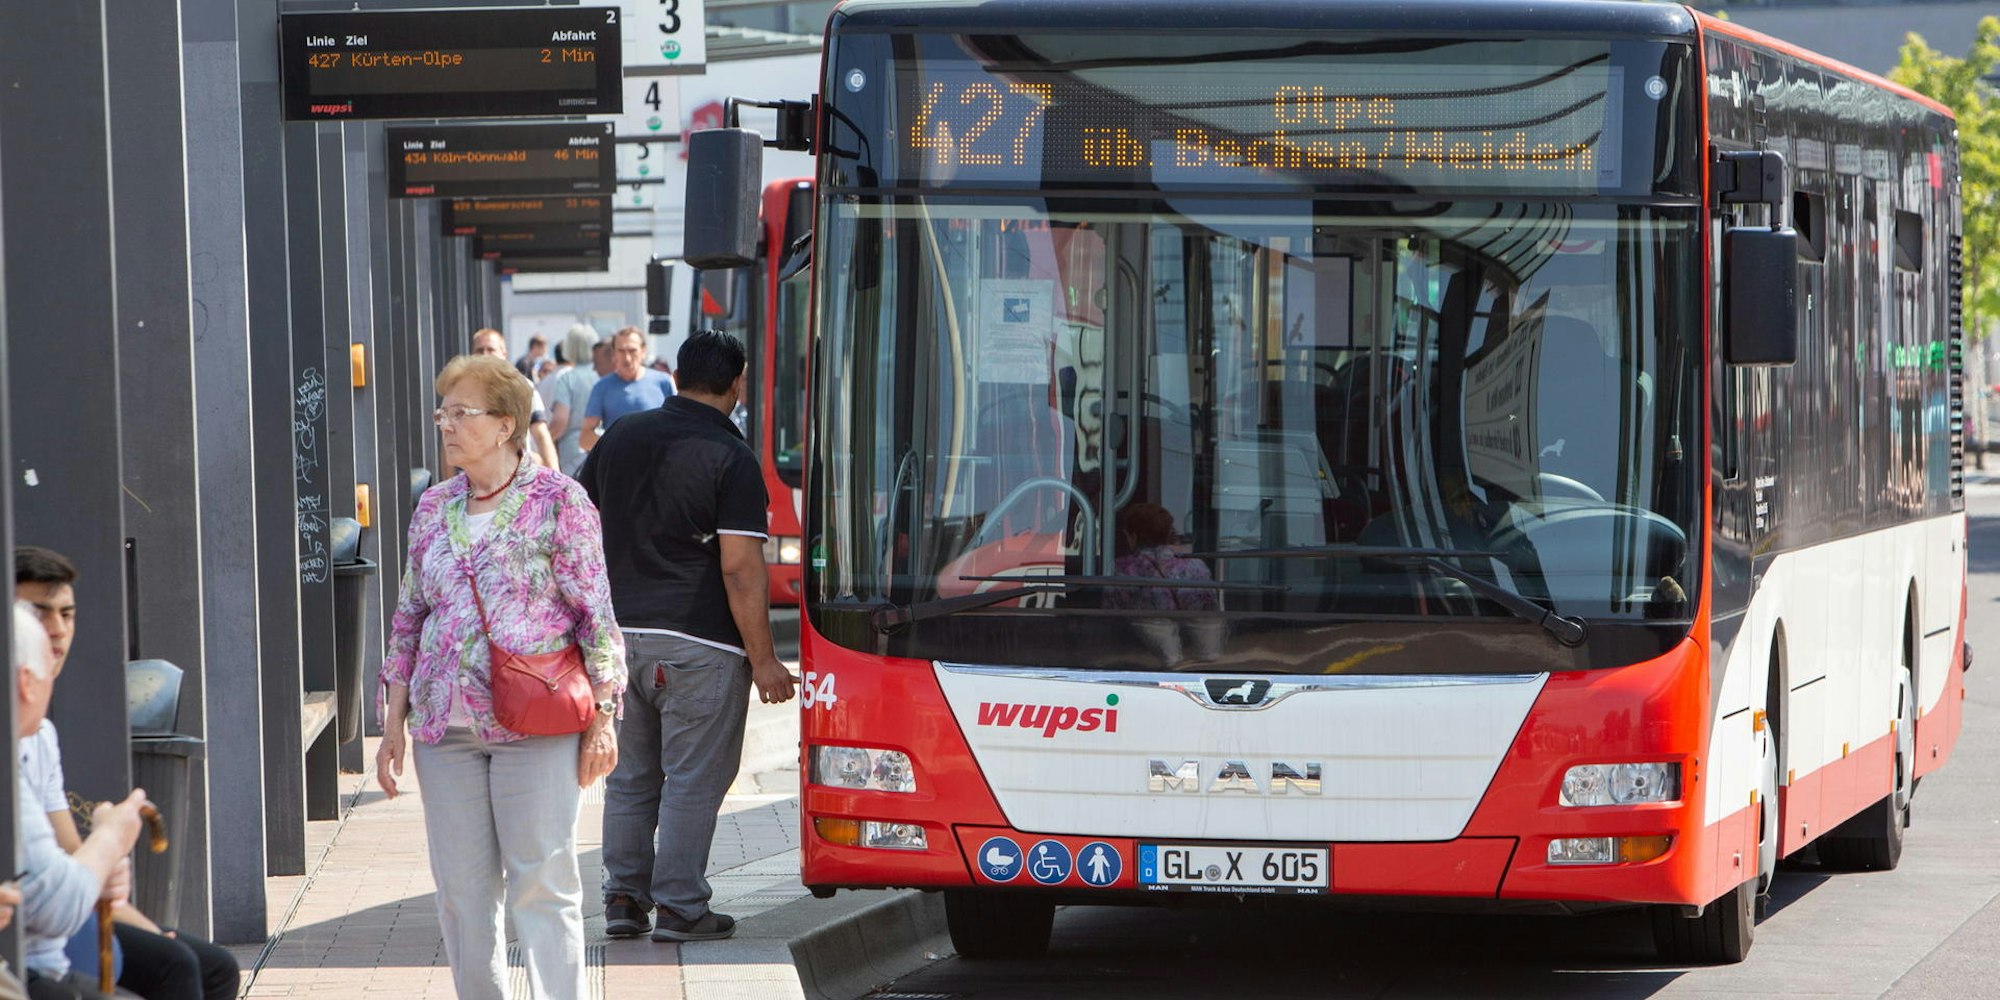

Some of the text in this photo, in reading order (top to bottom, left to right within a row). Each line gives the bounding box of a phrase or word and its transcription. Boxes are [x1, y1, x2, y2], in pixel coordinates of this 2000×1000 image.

[606, 10, 616, 24] 2
[658, 0, 681, 35] 3
[306, 35, 368, 47] Linie Ziel
[552, 31, 597, 42] Abfahrt
[308, 48, 595, 69] 427 Kürten-Olpe 2 Min
[645, 80, 662, 111] 4
[311, 101, 352, 115] wupsi
[1275, 86, 1395, 129] Olpe
[605, 124, 614, 134] 3
[911, 83, 1052, 165] 427
[403, 140, 446, 150] Linie Ziel
[568, 137, 600, 146] Abfahrt
[1085, 128, 1153, 167] üb.
[404, 152, 427, 164] 434
[554, 150, 569, 161] 46
[575, 149, 599, 160] Min
[977, 693, 1120, 739] wupsi
[1147, 759, 1323, 796] MAN
[1145, 850, 1318, 882] D GL X 605
